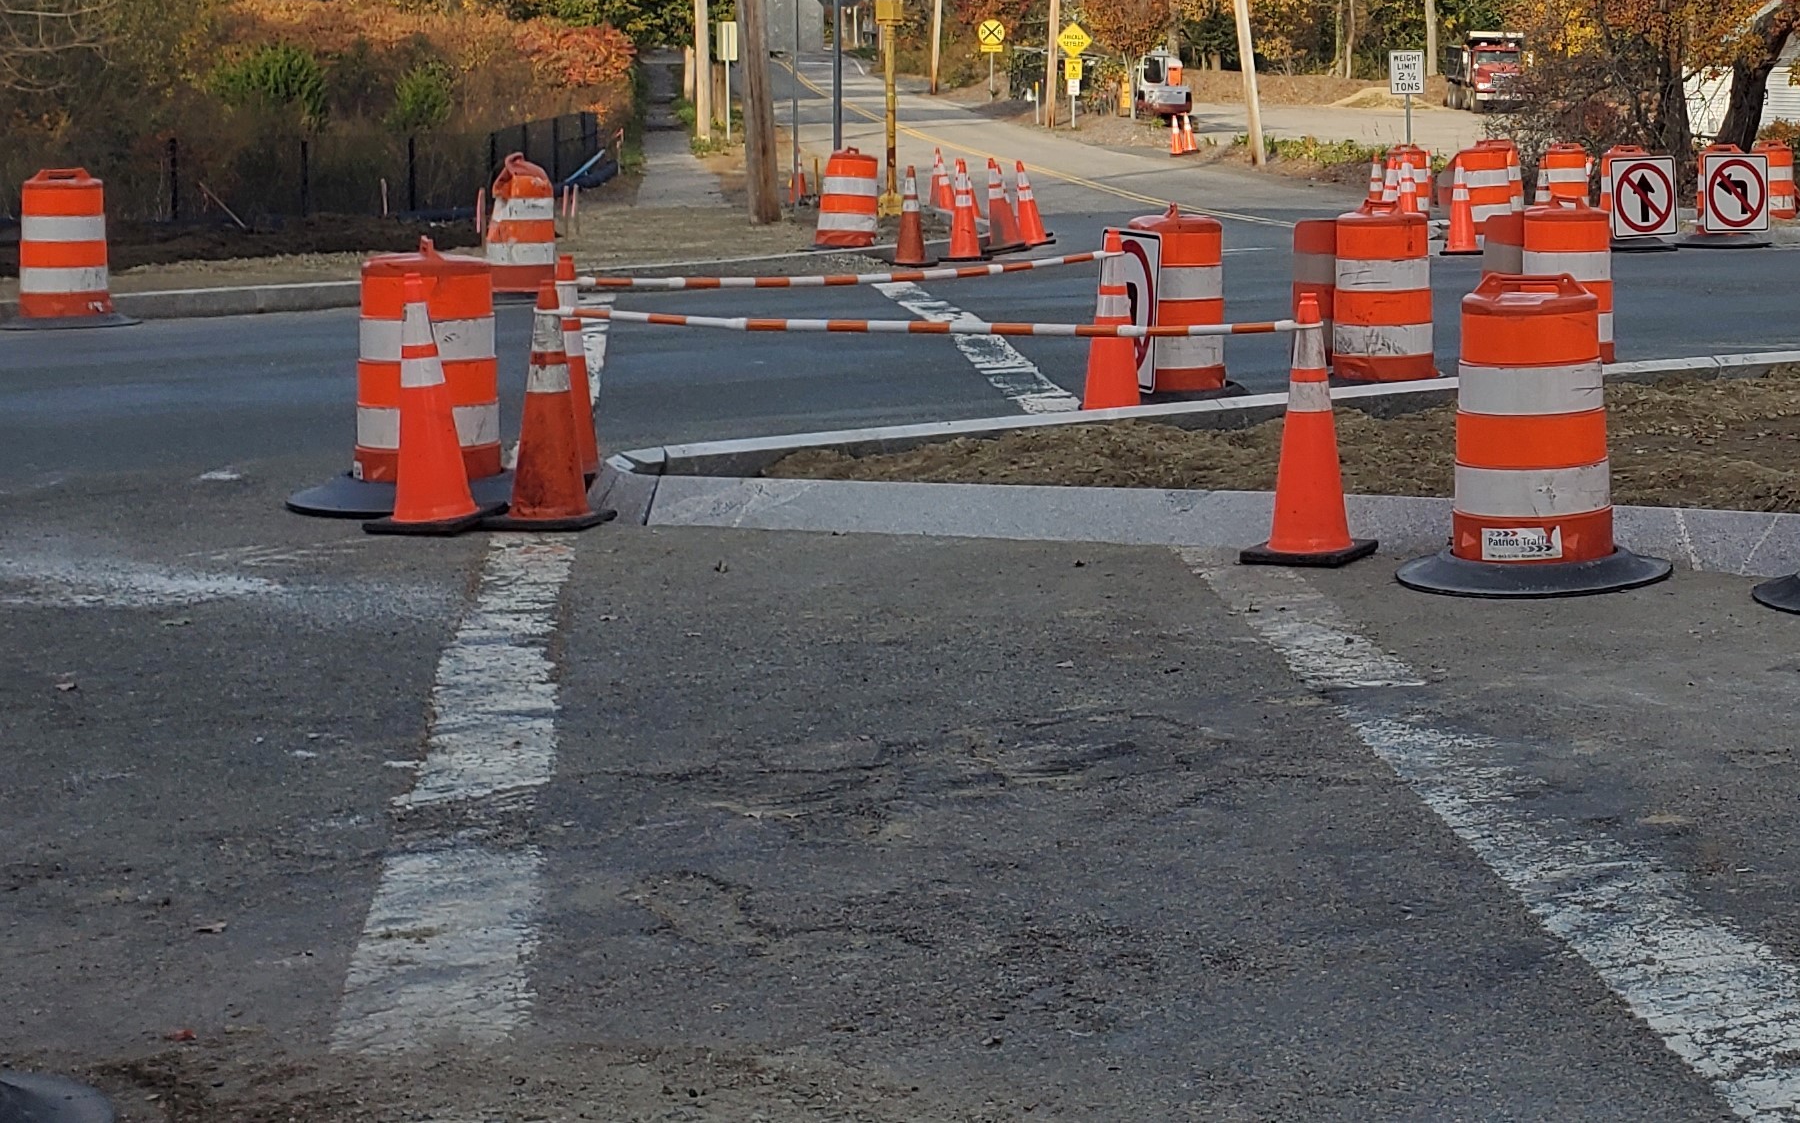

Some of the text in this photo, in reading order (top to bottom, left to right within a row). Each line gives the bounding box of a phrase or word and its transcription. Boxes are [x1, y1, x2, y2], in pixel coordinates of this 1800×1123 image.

[1393, 54, 1420, 62] WEIGHT
[1397, 63, 1417, 71] LIMIT
[1398, 72, 1405, 81] 2
[1395, 82, 1421, 91] TONS
[1488, 537, 1519, 547] Patriot
